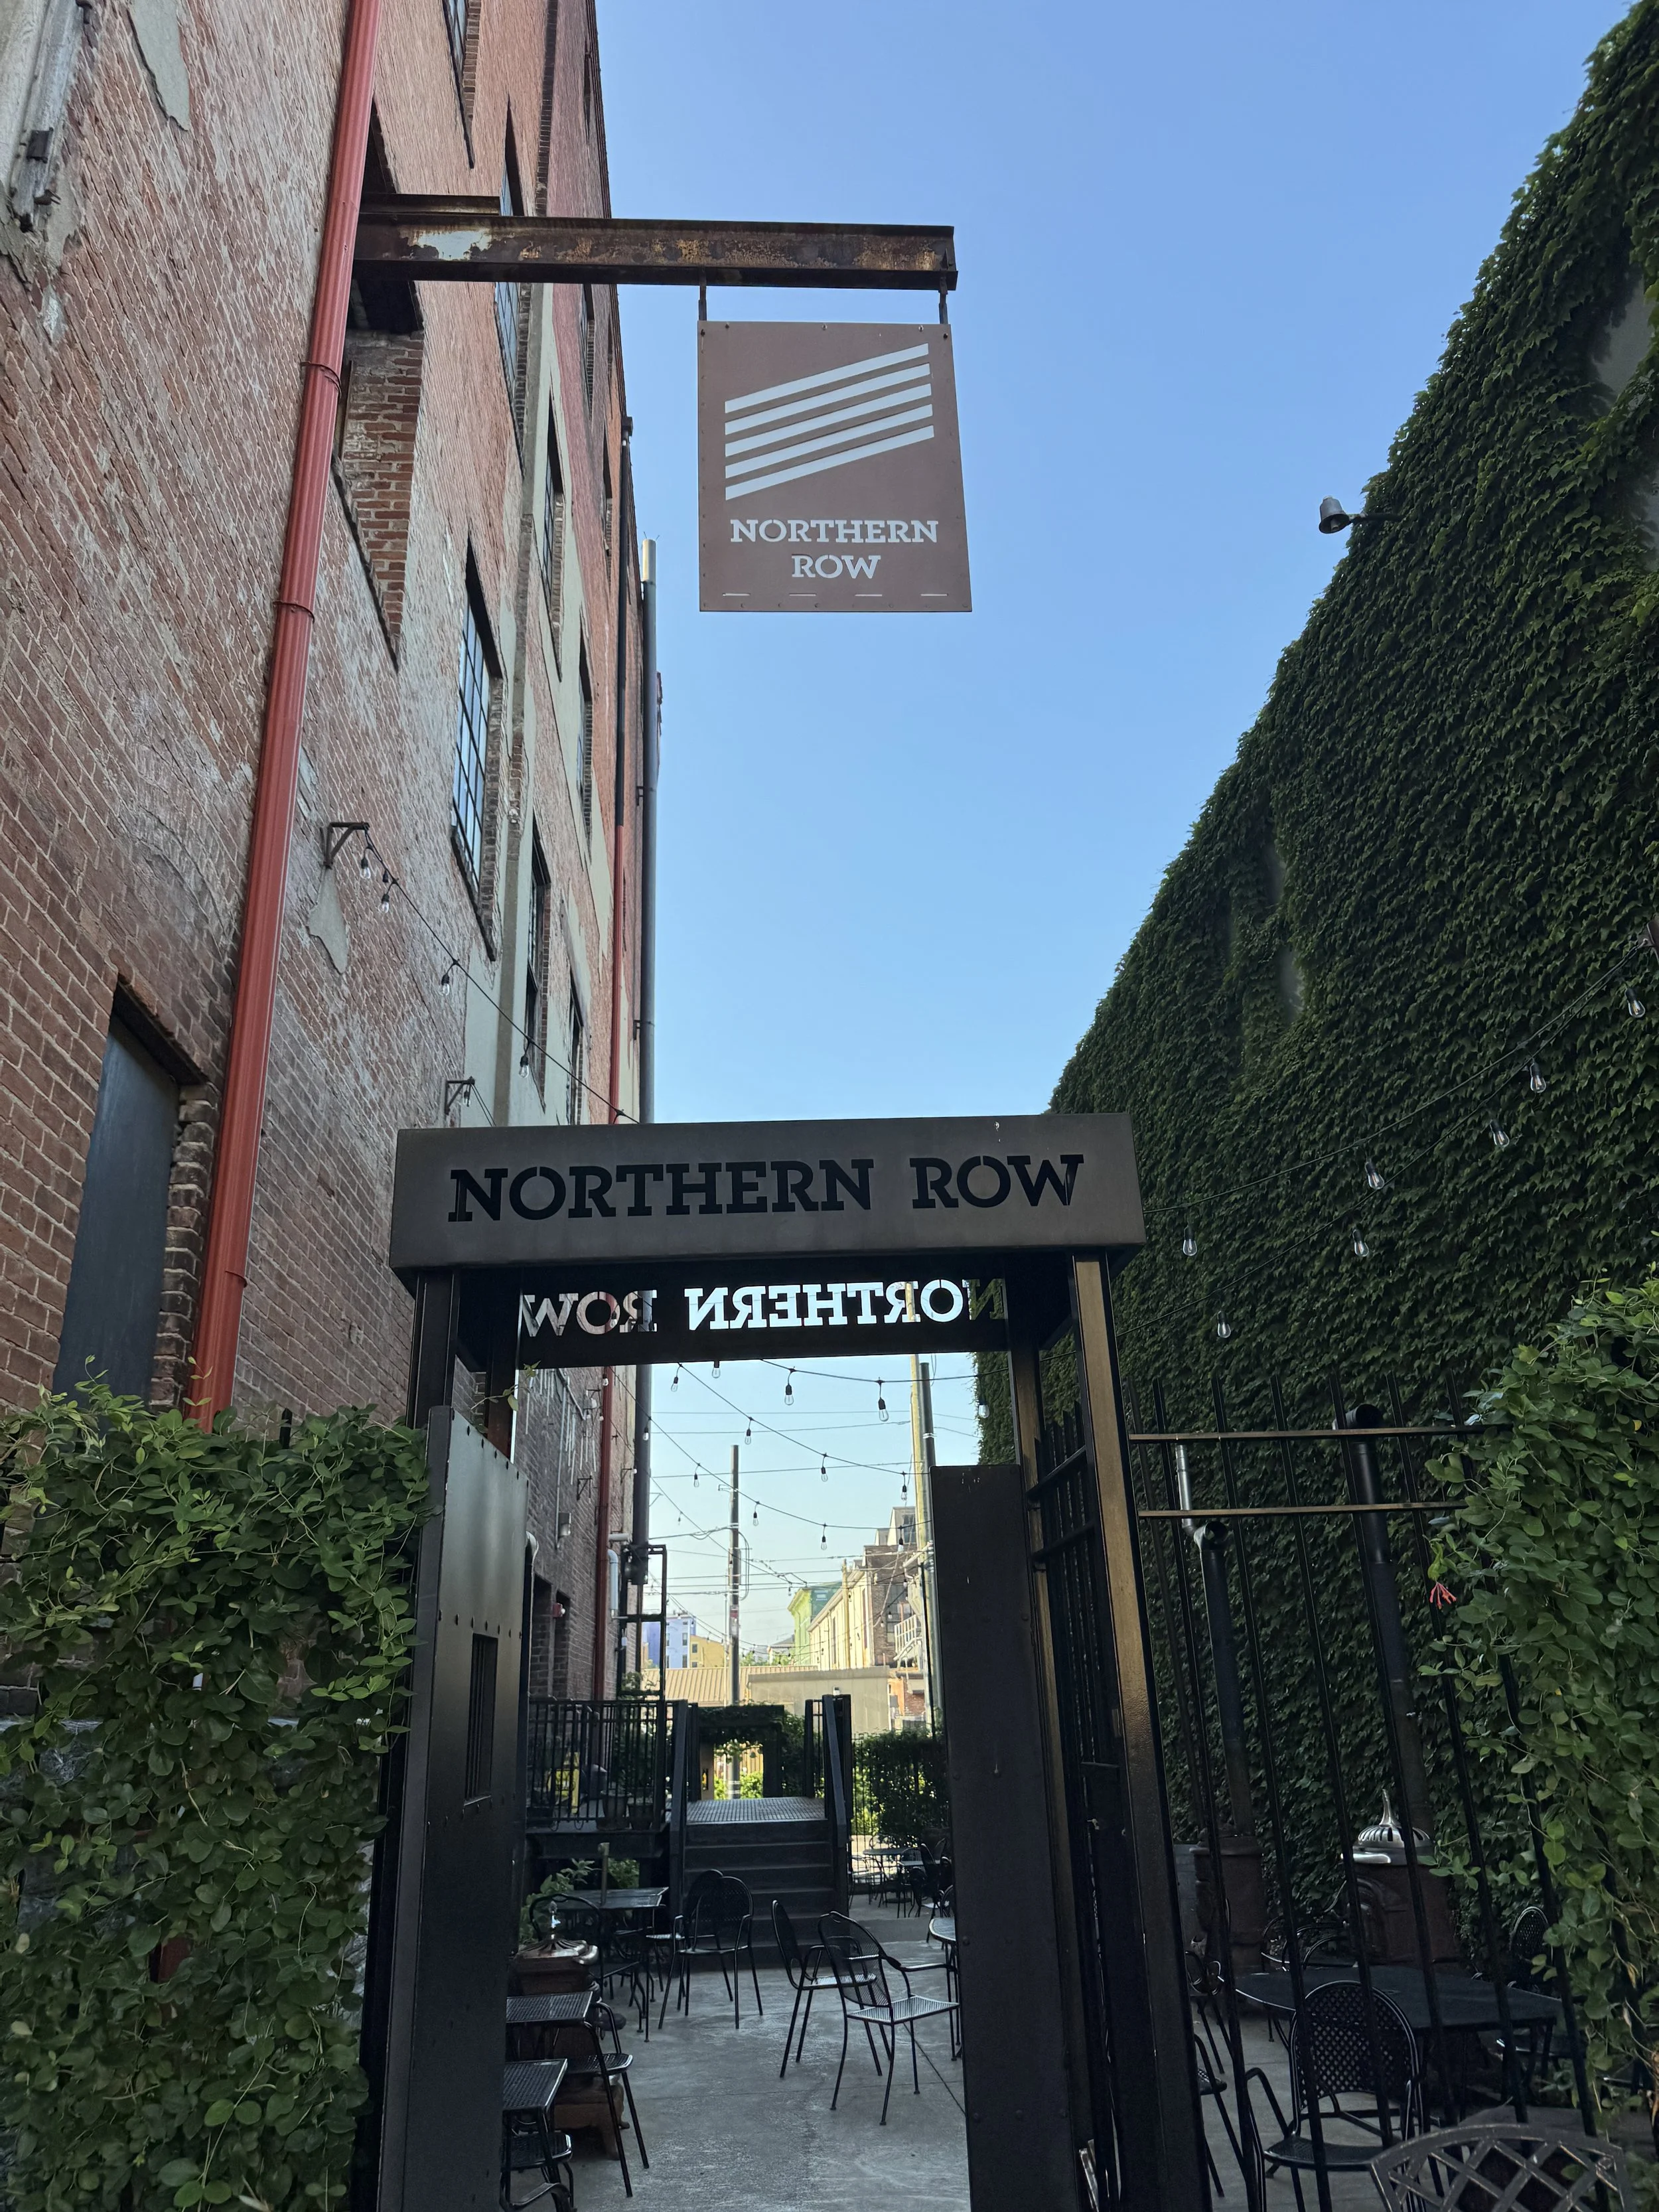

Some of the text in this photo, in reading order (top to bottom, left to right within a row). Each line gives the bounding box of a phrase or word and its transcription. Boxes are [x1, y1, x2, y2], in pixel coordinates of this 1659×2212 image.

[730, 520, 938, 543] NORTHERN
[791, 555, 881, 579] ROW
[449, 1155, 1084, 1222] NORTHERN ROW
